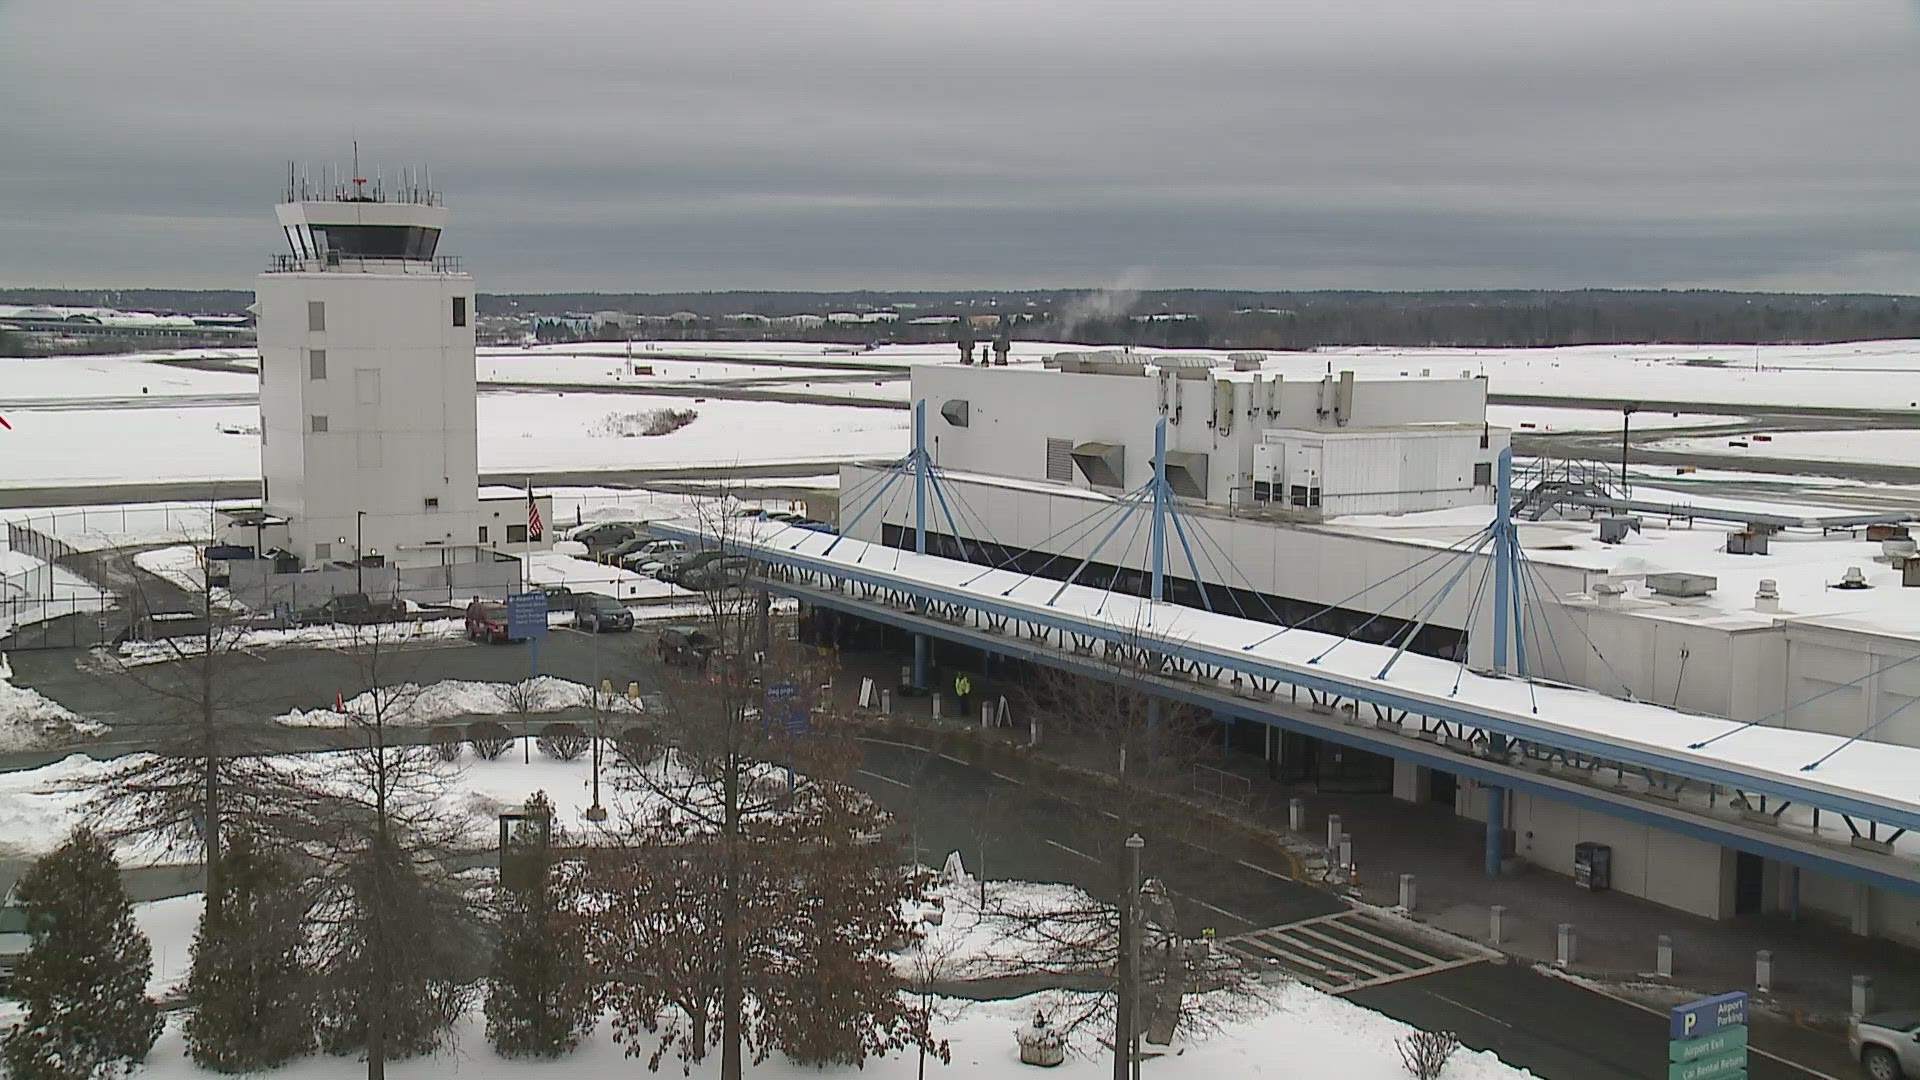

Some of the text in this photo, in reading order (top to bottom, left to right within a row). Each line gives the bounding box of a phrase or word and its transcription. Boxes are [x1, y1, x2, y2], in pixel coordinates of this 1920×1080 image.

[1718, 999, 1743, 1015] Airport
[1685, 1012, 1697, 1035] P
[1717, 1012, 1743, 1027] Parking
[1684, 1038, 1724, 1058] Airport Exit
[1697, 1060, 1720, 1077] Rental
[1721, 1055, 1744, 1070] Return
